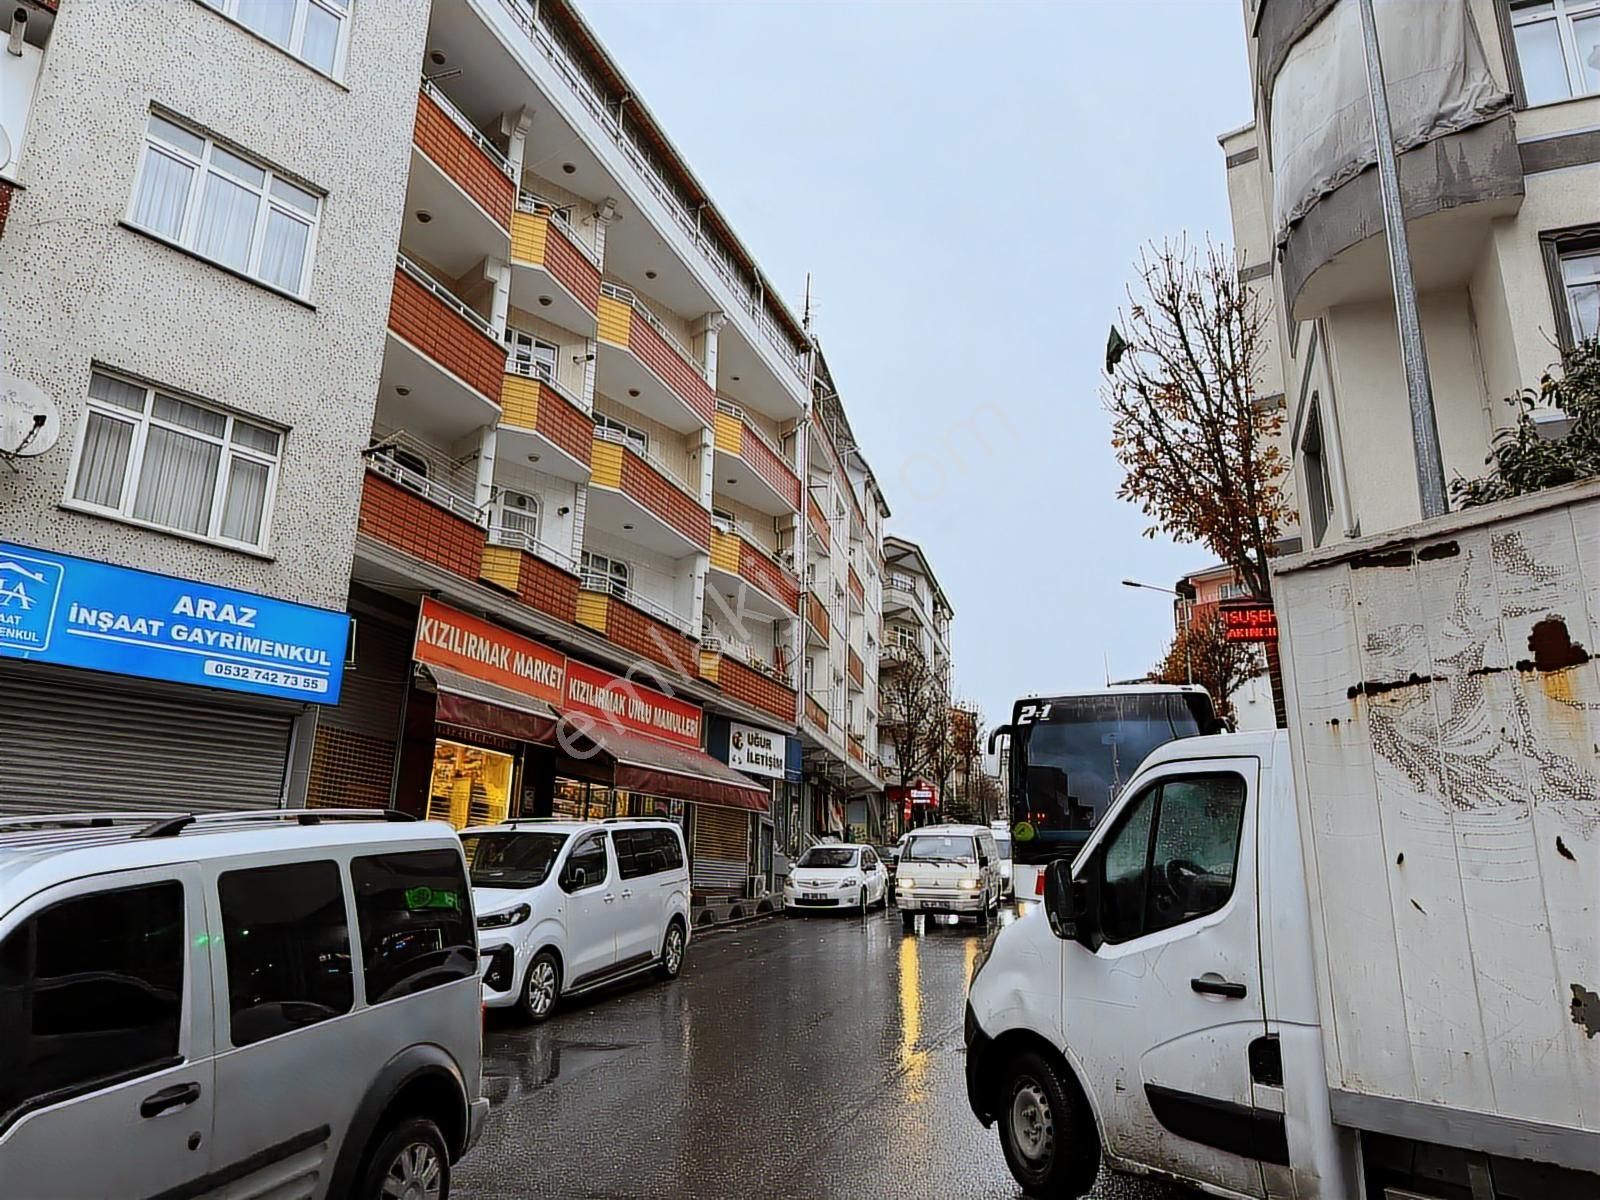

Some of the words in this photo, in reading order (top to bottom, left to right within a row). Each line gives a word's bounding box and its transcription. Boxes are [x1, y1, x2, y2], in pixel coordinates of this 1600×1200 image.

[172, 595, 257, 628] ARAZ
[68, 603, 164, 636] İNŞAAT
[171, 624, 331, 666] GAYRİMENKUL
[419, 616, 512, 671] KIZILIRMAK
[513, 651, 564, 689] MARKET
[215, 664, 249, 678] 0532
[254, 670, 278, 683] 742
[283, 675, 298, 686] 73
[303, 678, 318, 689] 55
[568, 677, 626, 717] KIZILIRMAK
[628, 697, 652, 724] UNLU
[747, 733, 772, 750] UĞUR
[746, 748, 783, 771] İLETİŞİM
